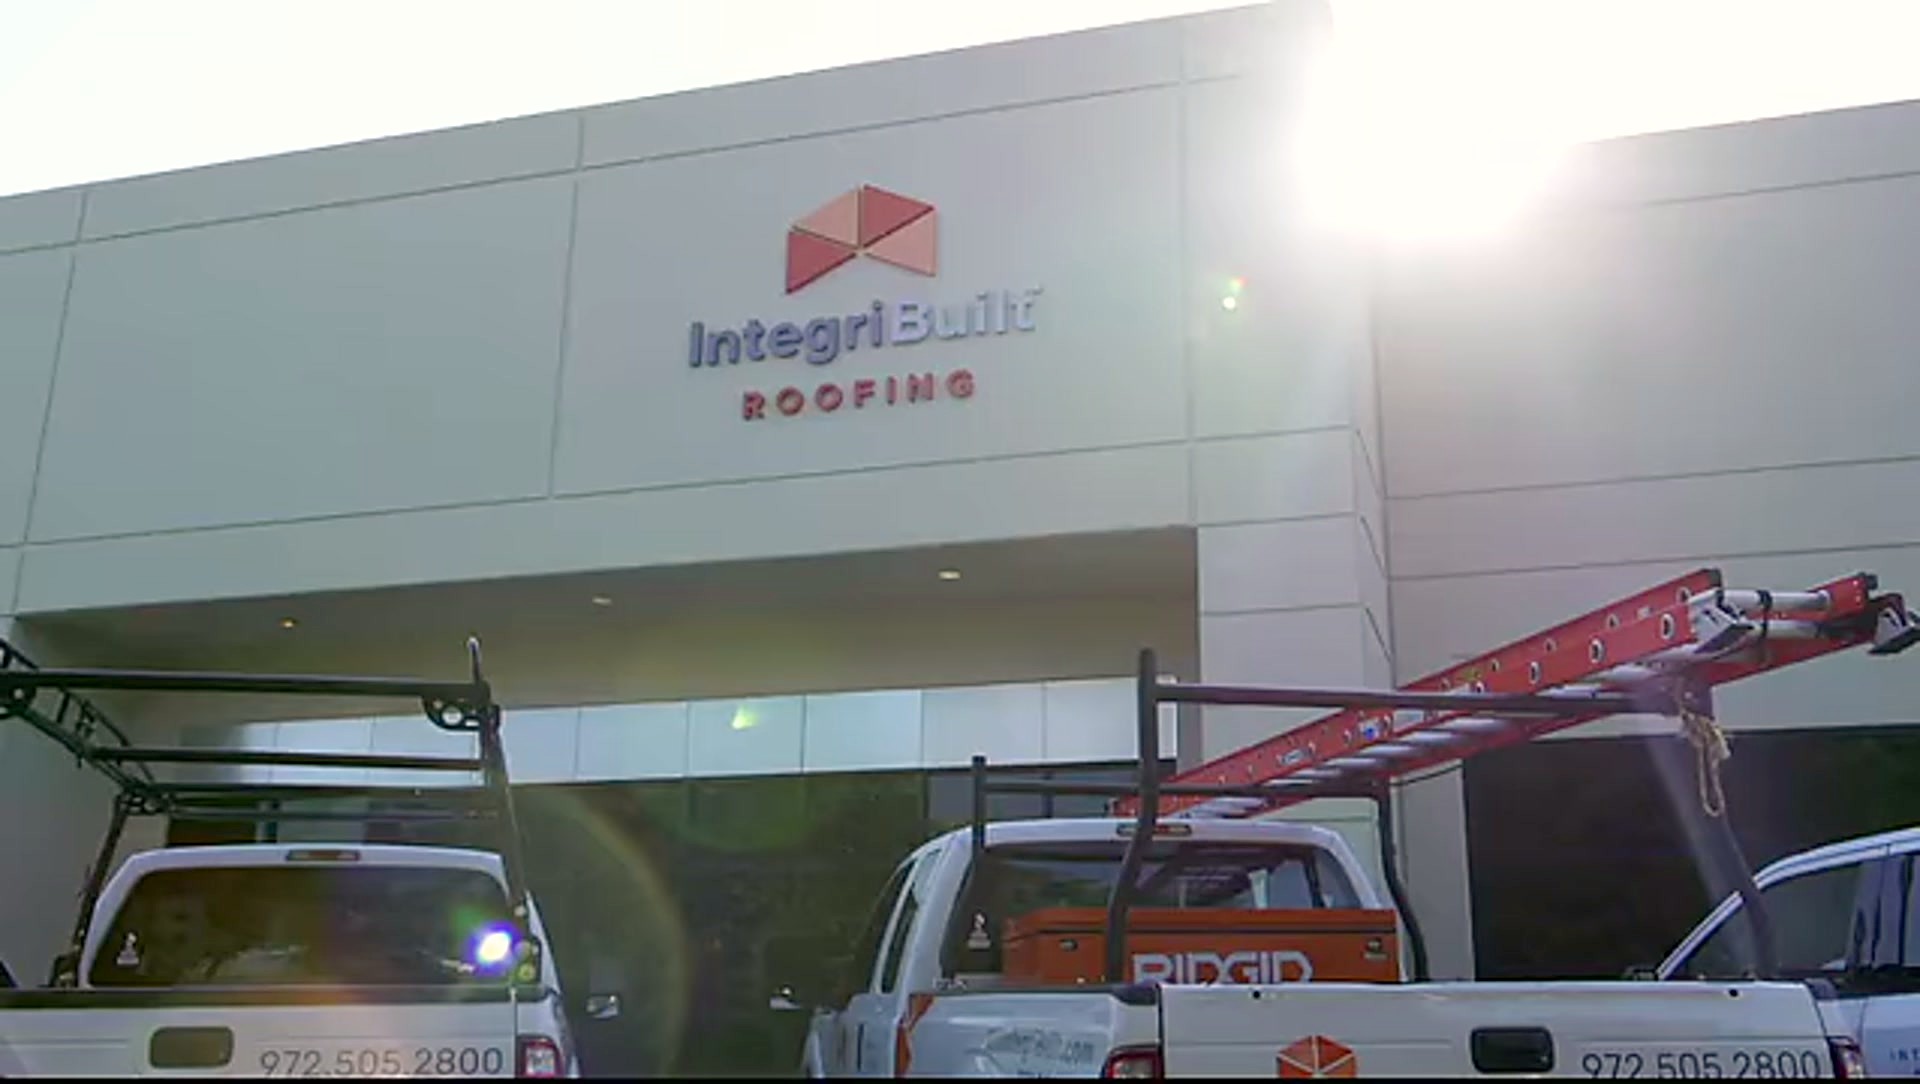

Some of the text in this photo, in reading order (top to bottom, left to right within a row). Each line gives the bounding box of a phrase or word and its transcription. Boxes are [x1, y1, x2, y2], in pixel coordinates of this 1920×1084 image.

[688, 290, 1037, 368] IntegriBuilt
[741, 369, 977, 421] ROOFING
[1132, 951, 1313, 984] RIDGID
[260, 1047, 504, 1076] 972.505.2800
[1582, 1051, 1821, 1077] 9725052800
